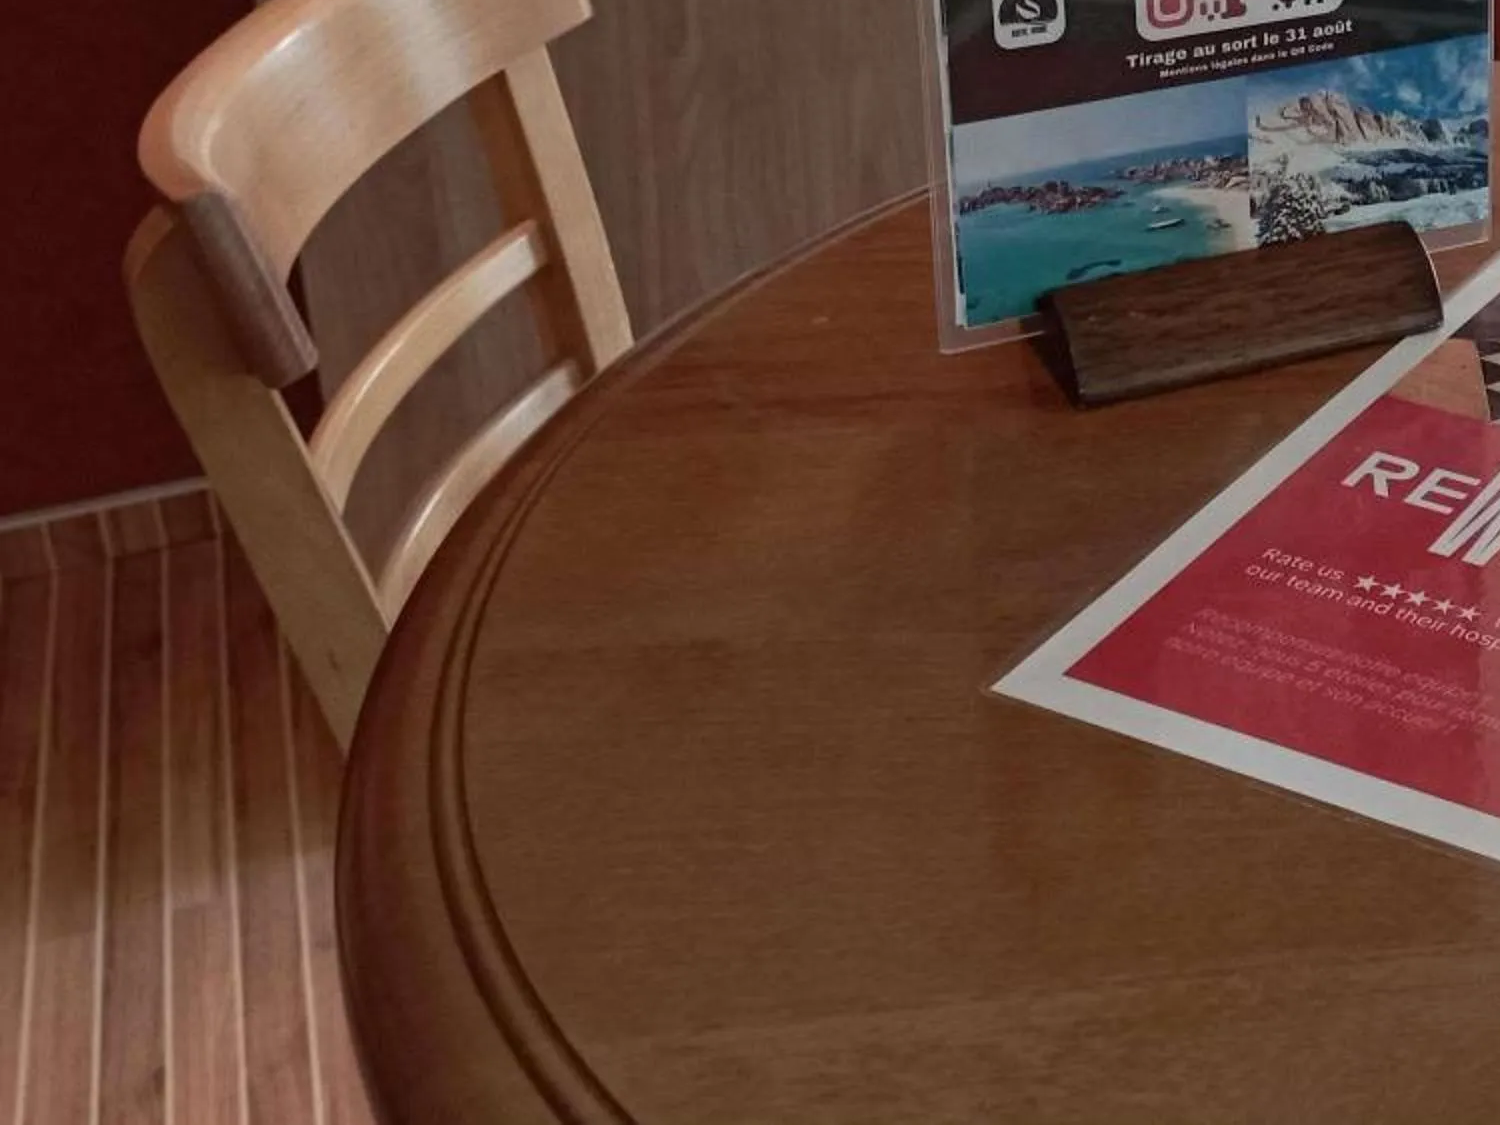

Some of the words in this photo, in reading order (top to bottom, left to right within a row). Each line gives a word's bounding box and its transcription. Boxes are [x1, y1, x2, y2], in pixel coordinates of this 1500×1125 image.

[1126, 49, 1187, 69] Tirage
[1193, 43, 1216, 58] au
[1222, 37, 1258, 53] sort
[1264, 31, 1280, 46] le
[1285, 26, 1308, 44] 31
[1313, 20, 1353, 39] août
[1261, 547, 1315, 573] Rate
[1317, 562, 1345, 581] us
[1245, 563, 1281, 583] our
[1286, 572, 1344, 602] team
[1345, 593, 1396, 618] and
[1395, 607, 1451, 638] their
